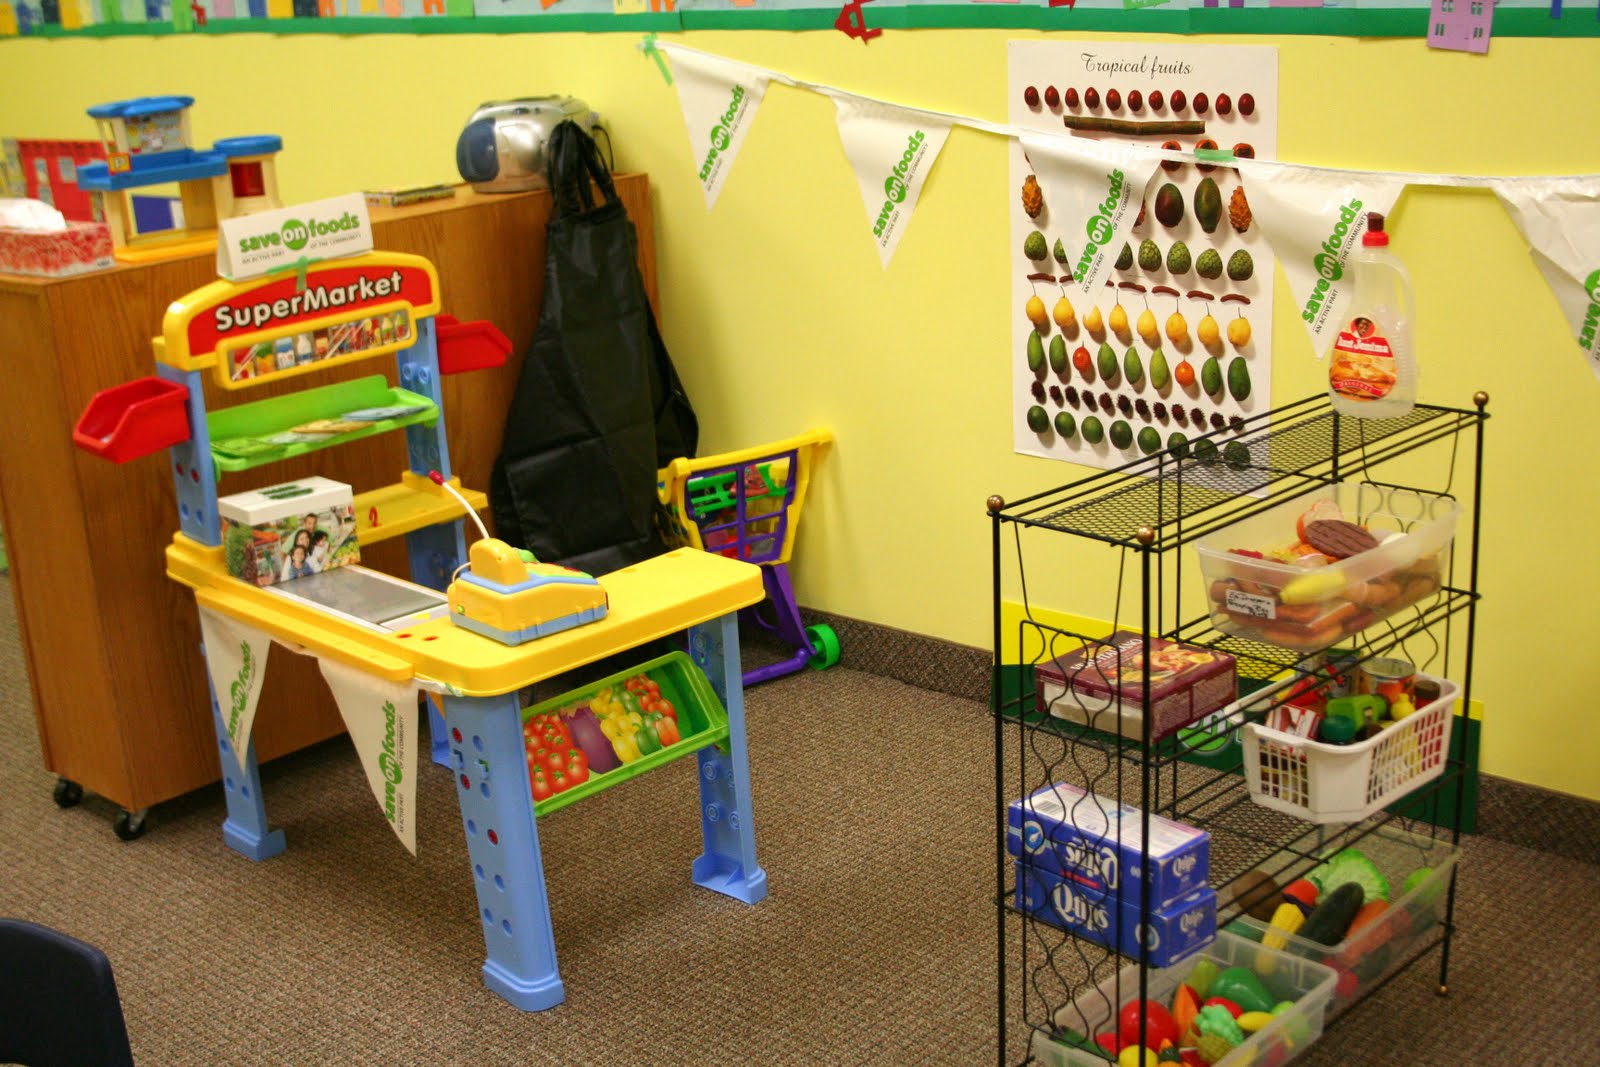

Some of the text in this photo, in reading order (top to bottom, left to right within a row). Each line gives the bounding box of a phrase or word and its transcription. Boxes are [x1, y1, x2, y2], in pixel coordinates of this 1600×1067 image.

[1081, 53, 1194, 80] Tropical fruits
[699, 148, 718, 183] save
[721, 84, 744, 128] foods
[239, 232, 281, 253] save
[308, 212, 360, 238] foods
[873, 200, 894, 238] save
[893, 130, 925, 179] foods
[1073, 168, 1124, 283] save on foods
[1088, 266, 1098, 286] ACTIVE
[1096, 253, 1105, 267] PART
[1121, 183, 1132, 211] COMMUNITY
[1302, 198, 1363, 324] save on foods
[1320, 305, 1332, 326] ACTIVE
[1329, 289, 1339, 305] PART
[1345, 213, 1368, 250] COMMUNITY
[215, 270, 403, 332] SuperMarket
[382, 700, 396, 756] foods
[385, 781, 396, 823] save
